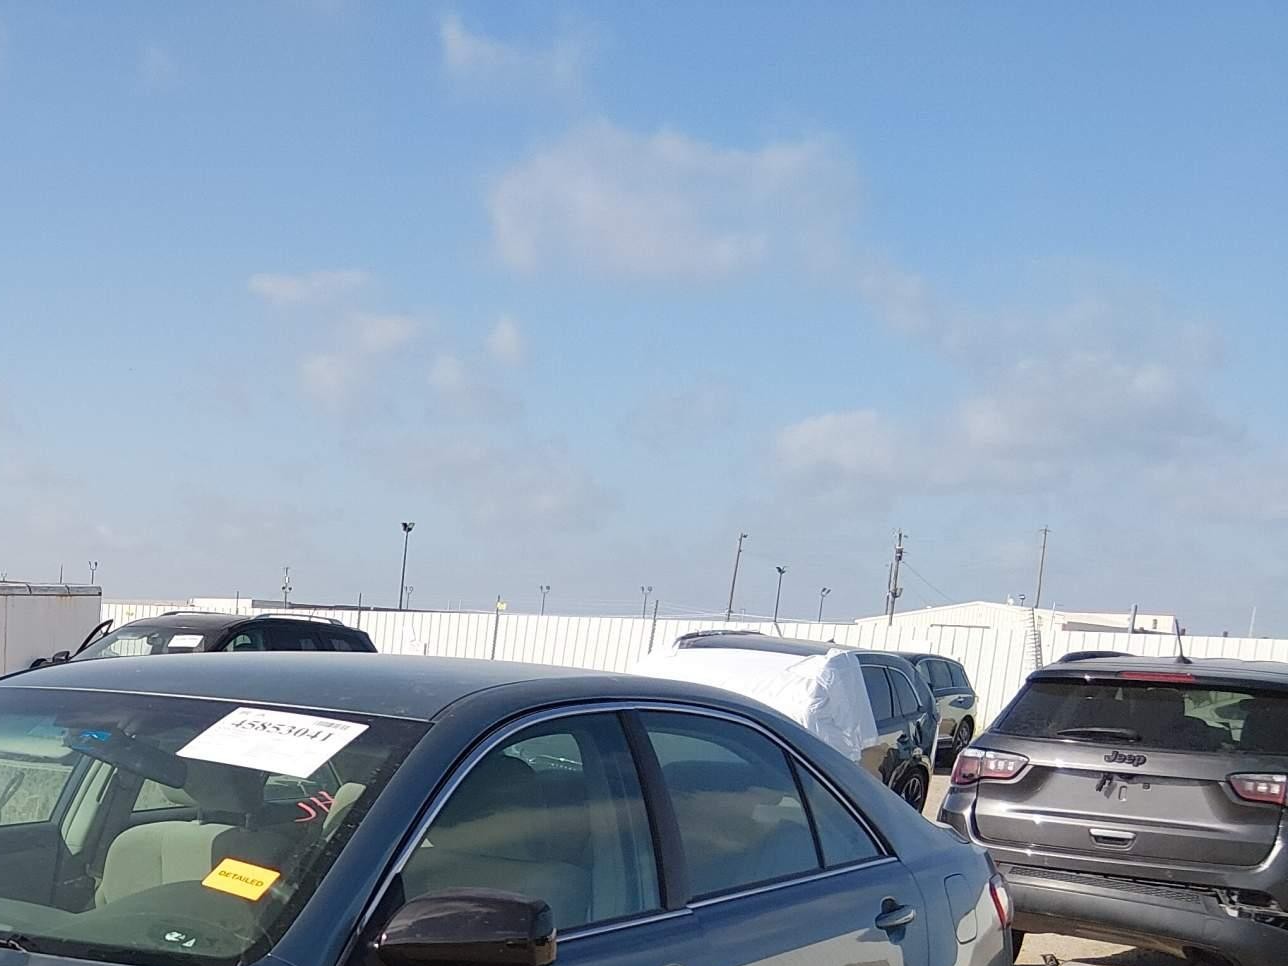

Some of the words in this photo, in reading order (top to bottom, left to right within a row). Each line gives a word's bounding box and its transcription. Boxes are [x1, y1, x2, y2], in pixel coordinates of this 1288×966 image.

[231, 718, 335, 742] 45853041
[1103, 750, 1147, 767] Jeep
[218, 870, 264, 887] DETAILED
